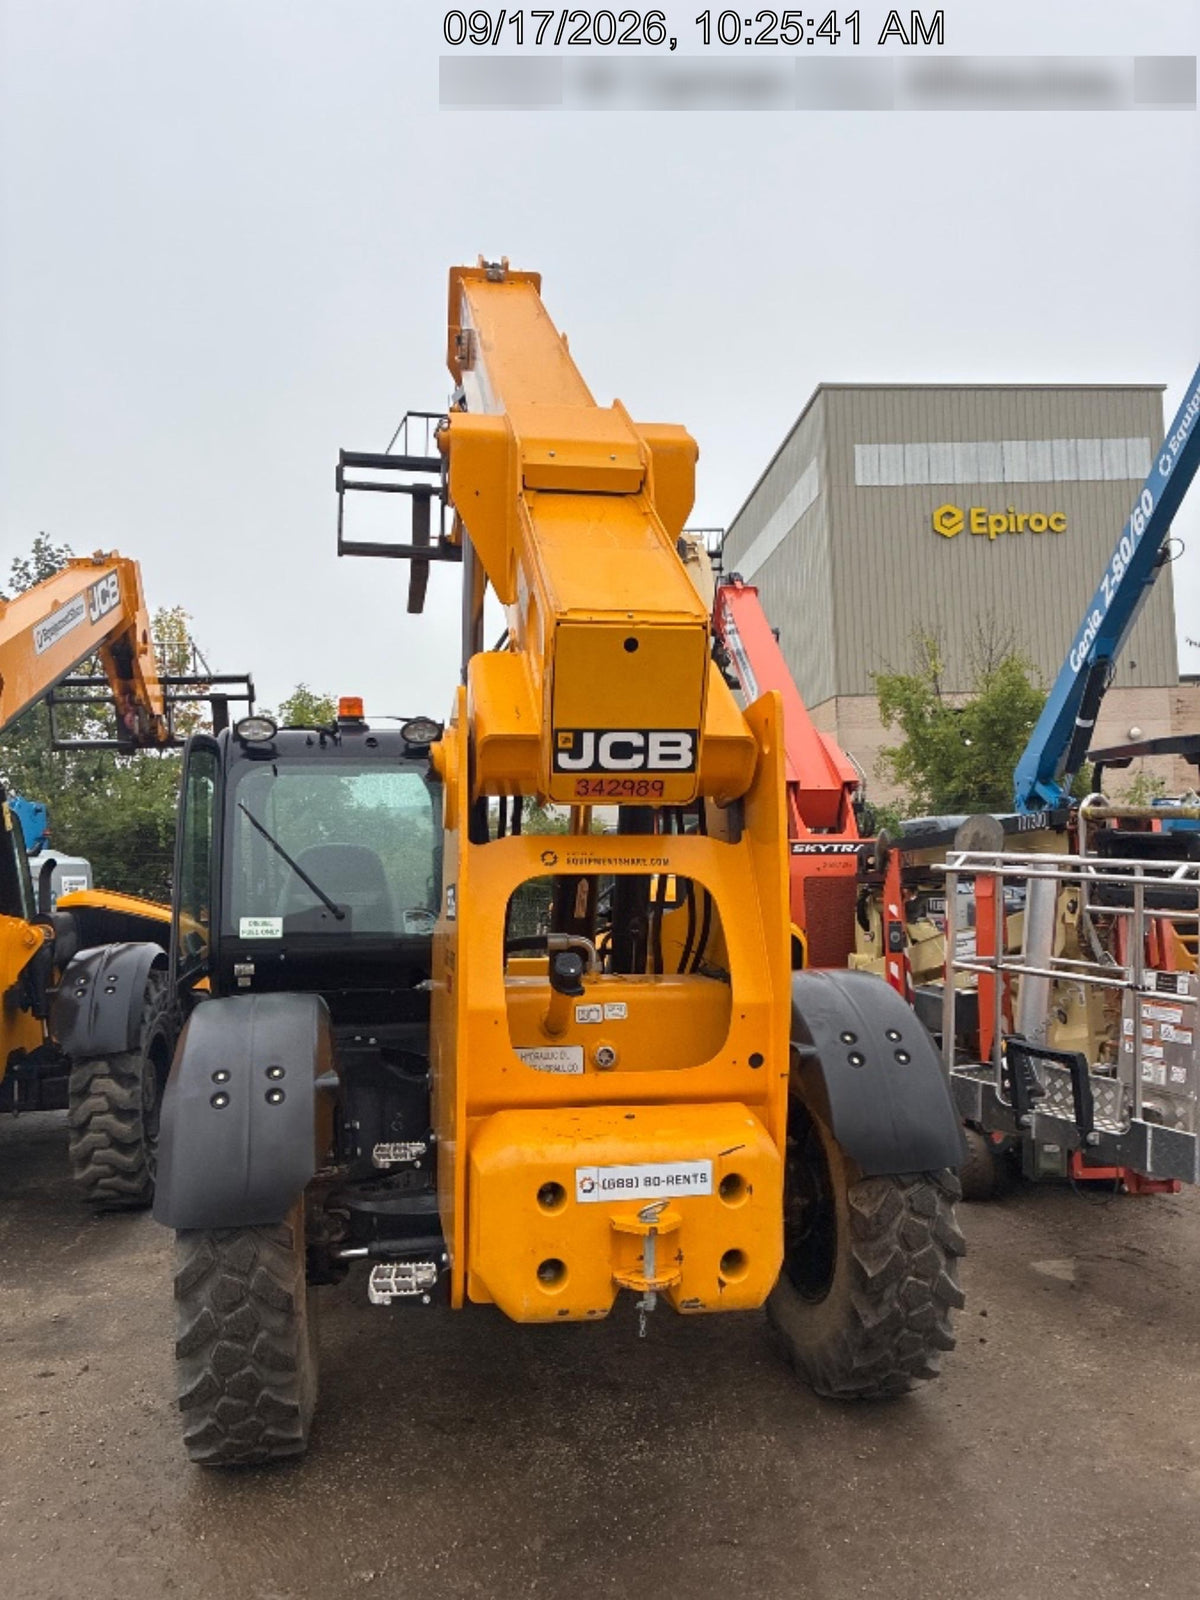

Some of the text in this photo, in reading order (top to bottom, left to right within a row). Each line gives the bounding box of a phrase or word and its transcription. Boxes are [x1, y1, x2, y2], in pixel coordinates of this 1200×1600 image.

[1168, 383, 1200, 456] Equip
[969, 504, 1067, 540] Epiroc
[90, 573, 119, 622] JCB
[1070, 488, 1153, 672] Genie Z-80/60
[557, 731, 693, 769] JCB
[575, 779, 665, 797] 342989
[643, 1172, 708, 1187] 80-RENTS
